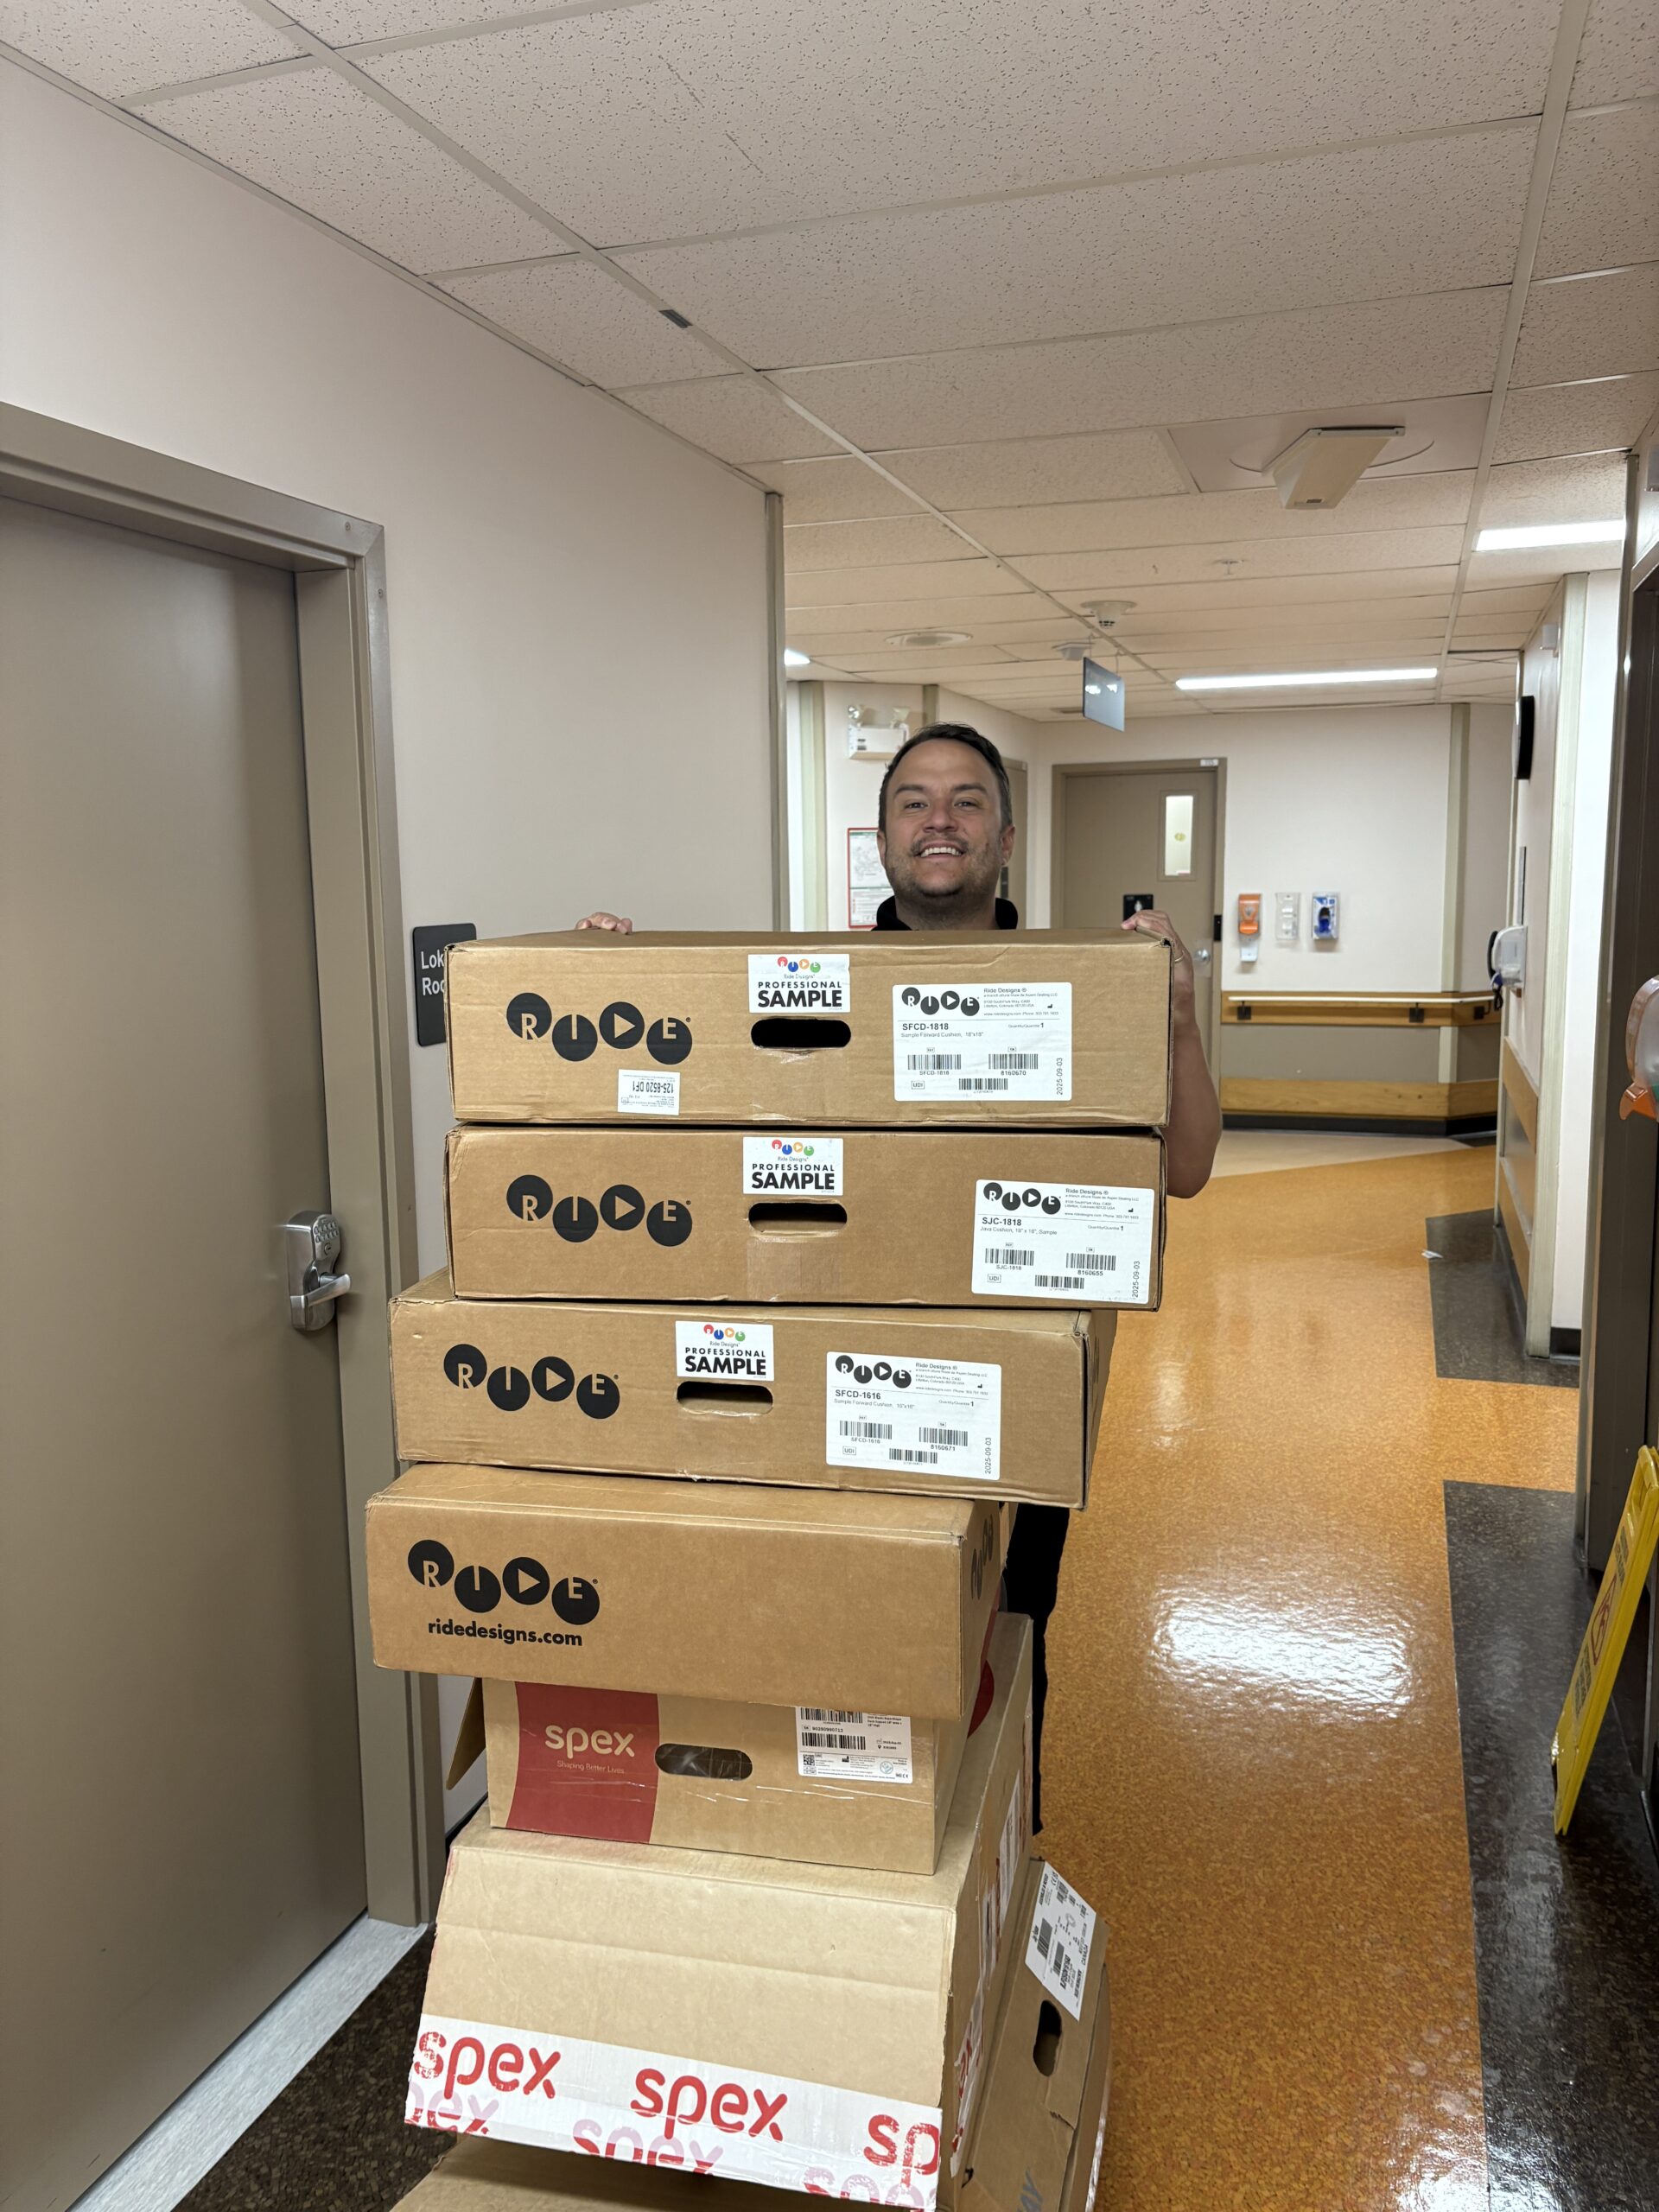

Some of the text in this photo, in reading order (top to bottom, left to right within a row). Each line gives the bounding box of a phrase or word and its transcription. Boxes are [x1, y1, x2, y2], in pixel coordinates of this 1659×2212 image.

[758, 989, 842, 1007] SAMPLE
[752, 1163, 835, 1172] PROFESSIONAL
[752, 1172, 835, 1190] SAMPLE
[982, 1217, 1022, 1226] SJC-1818
[1132, 1262, 1141, 1298] 2025-09-03
[685, 1347, 766, 1357] PROFESSIONAL
[685, 1355, 766, 1376] SAMPLE
[835, 1389, 881, 1400] SFCD-1616
[429, 1618, 582, 1646] ridedesigns.com
[544, 1725, 635, 1759] spex
[556, 1760, 585, 1771] Shaping
[414, 2031, 562, 2100] spex
[630, 2068, 788, 2142] spex
